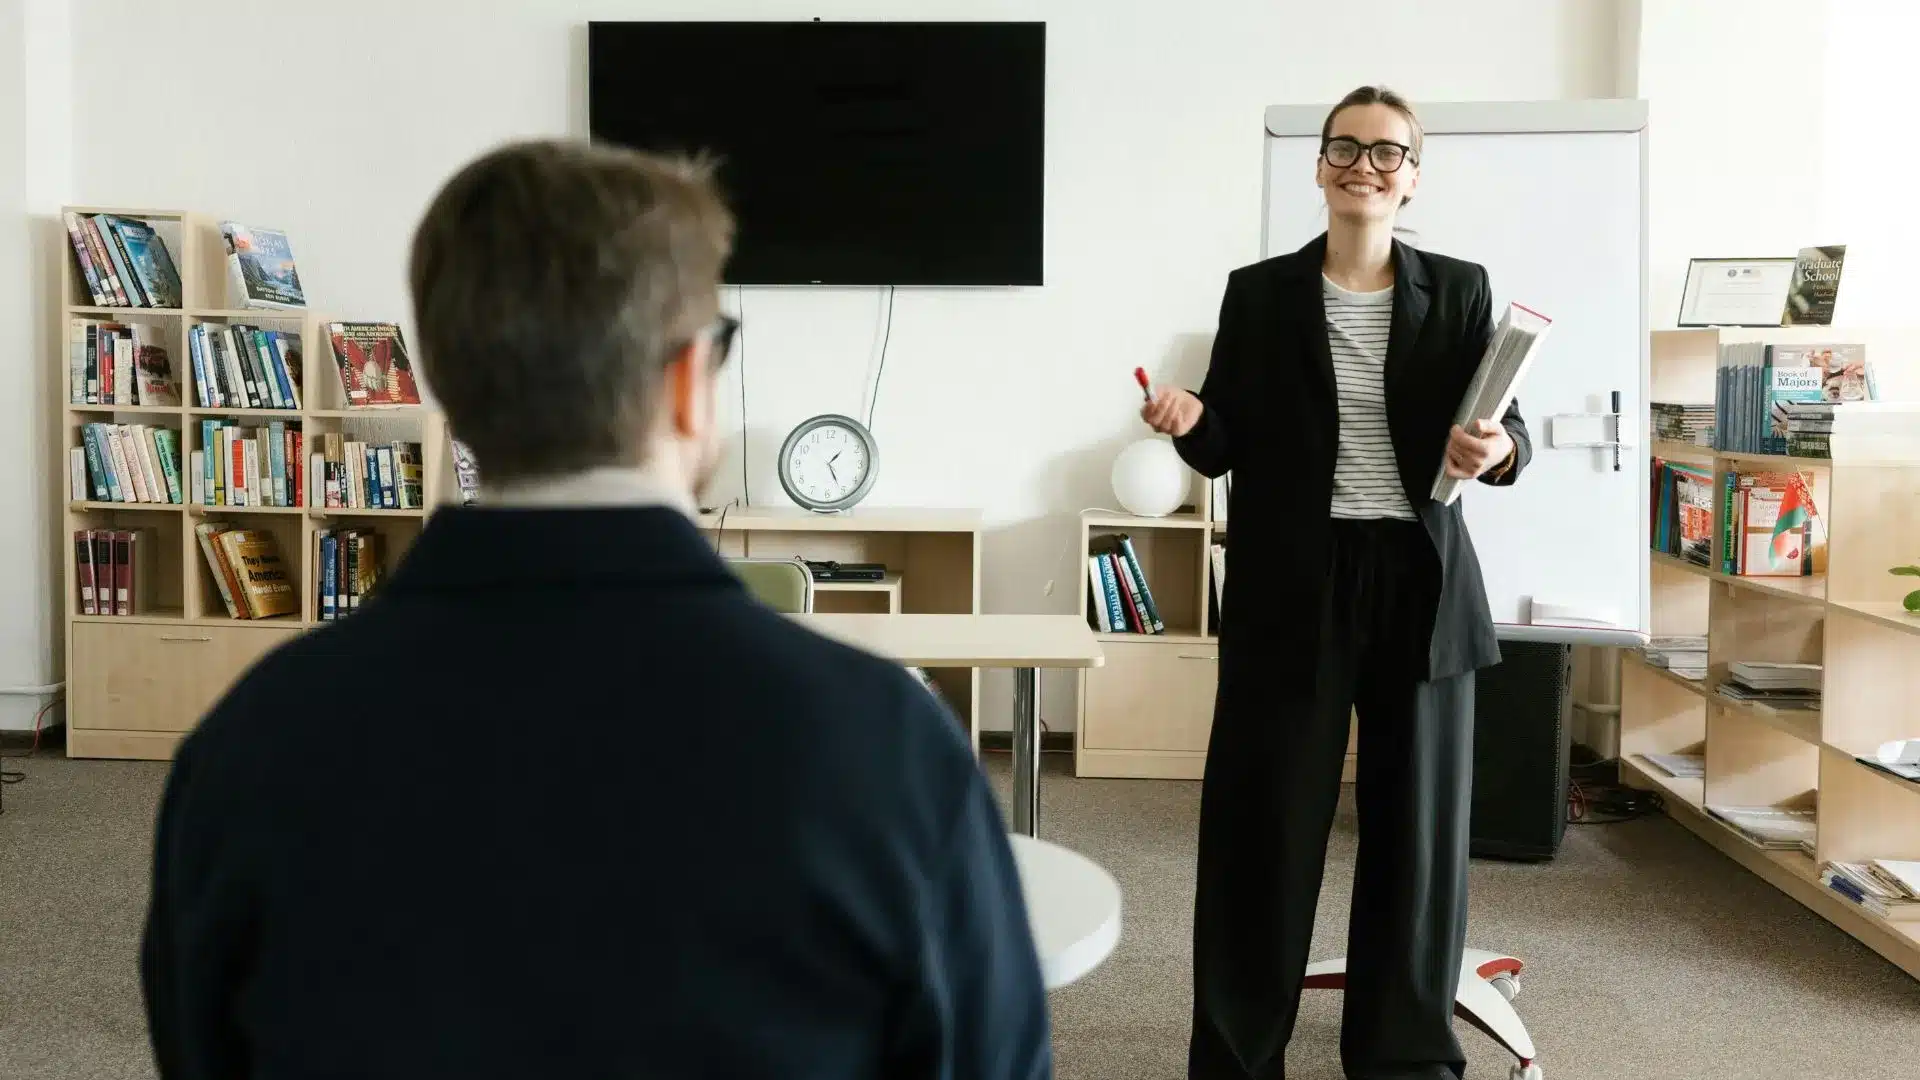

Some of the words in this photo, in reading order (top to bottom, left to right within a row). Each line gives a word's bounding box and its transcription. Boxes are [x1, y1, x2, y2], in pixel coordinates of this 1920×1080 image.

[1797, 257, 1842, 270] Graduate
[1804, 267, 1840, 281] School
[1777, 370, 1799, 378] Book
[1800, 370, 1808, 378] of
[1777, 377, 1818, 388] Majors
[811, 433, 820, 444] 11
[825, 429, 836, 439] 12
[843, 434, 848, 444] 1
[799, 444, 810, 454] 10
[853, 444, 860, 454] 2
[795, 459, 802, 469] 9
[857, 459, 863, 469] 3
[799, 474, 805, 485] 8
[851, 475, 858, 485] 4
[809, 485, 816, 495] 7
[824, 488, 831, 499] 6
[840, 485, 847, 495] 5
[241, 556, 260, 567] They
[248, 569, 286, 583] America
[1103, 555, 1116, 594] CULTURAL
[252, 584, 272, 595] Harold
[273, 583, 292, 593] Evans
